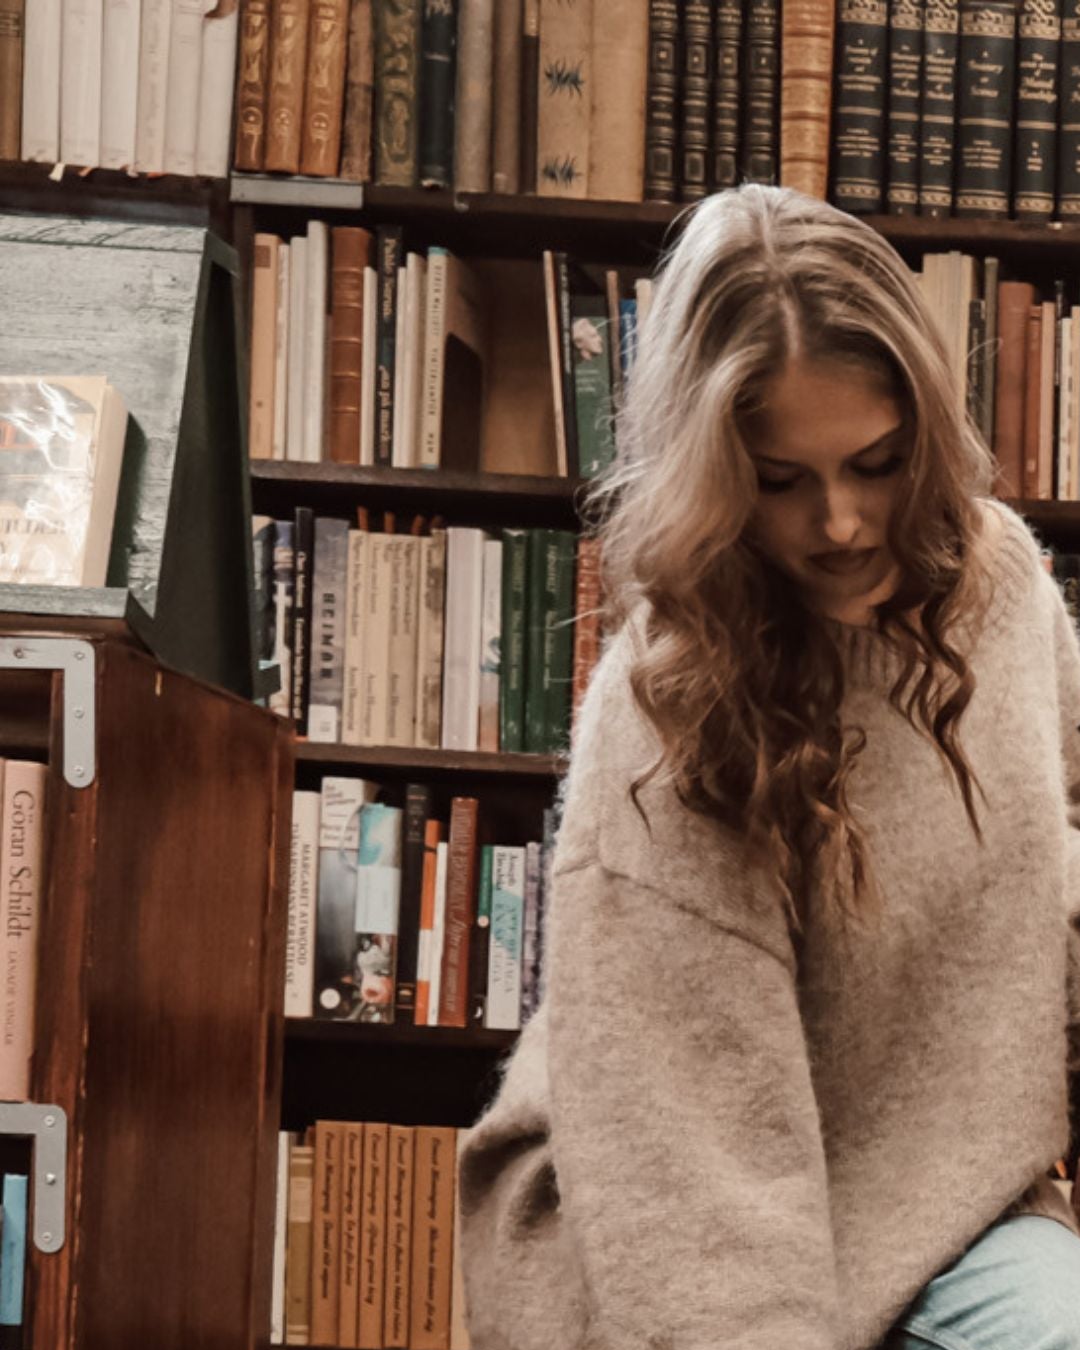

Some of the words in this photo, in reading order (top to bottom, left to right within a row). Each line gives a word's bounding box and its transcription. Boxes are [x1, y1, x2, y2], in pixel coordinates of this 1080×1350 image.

[10, 789, 36, 857] Göran
[6, 866, 33, 938] Schildt
[297, 911, 309, 966] ATWOOD
